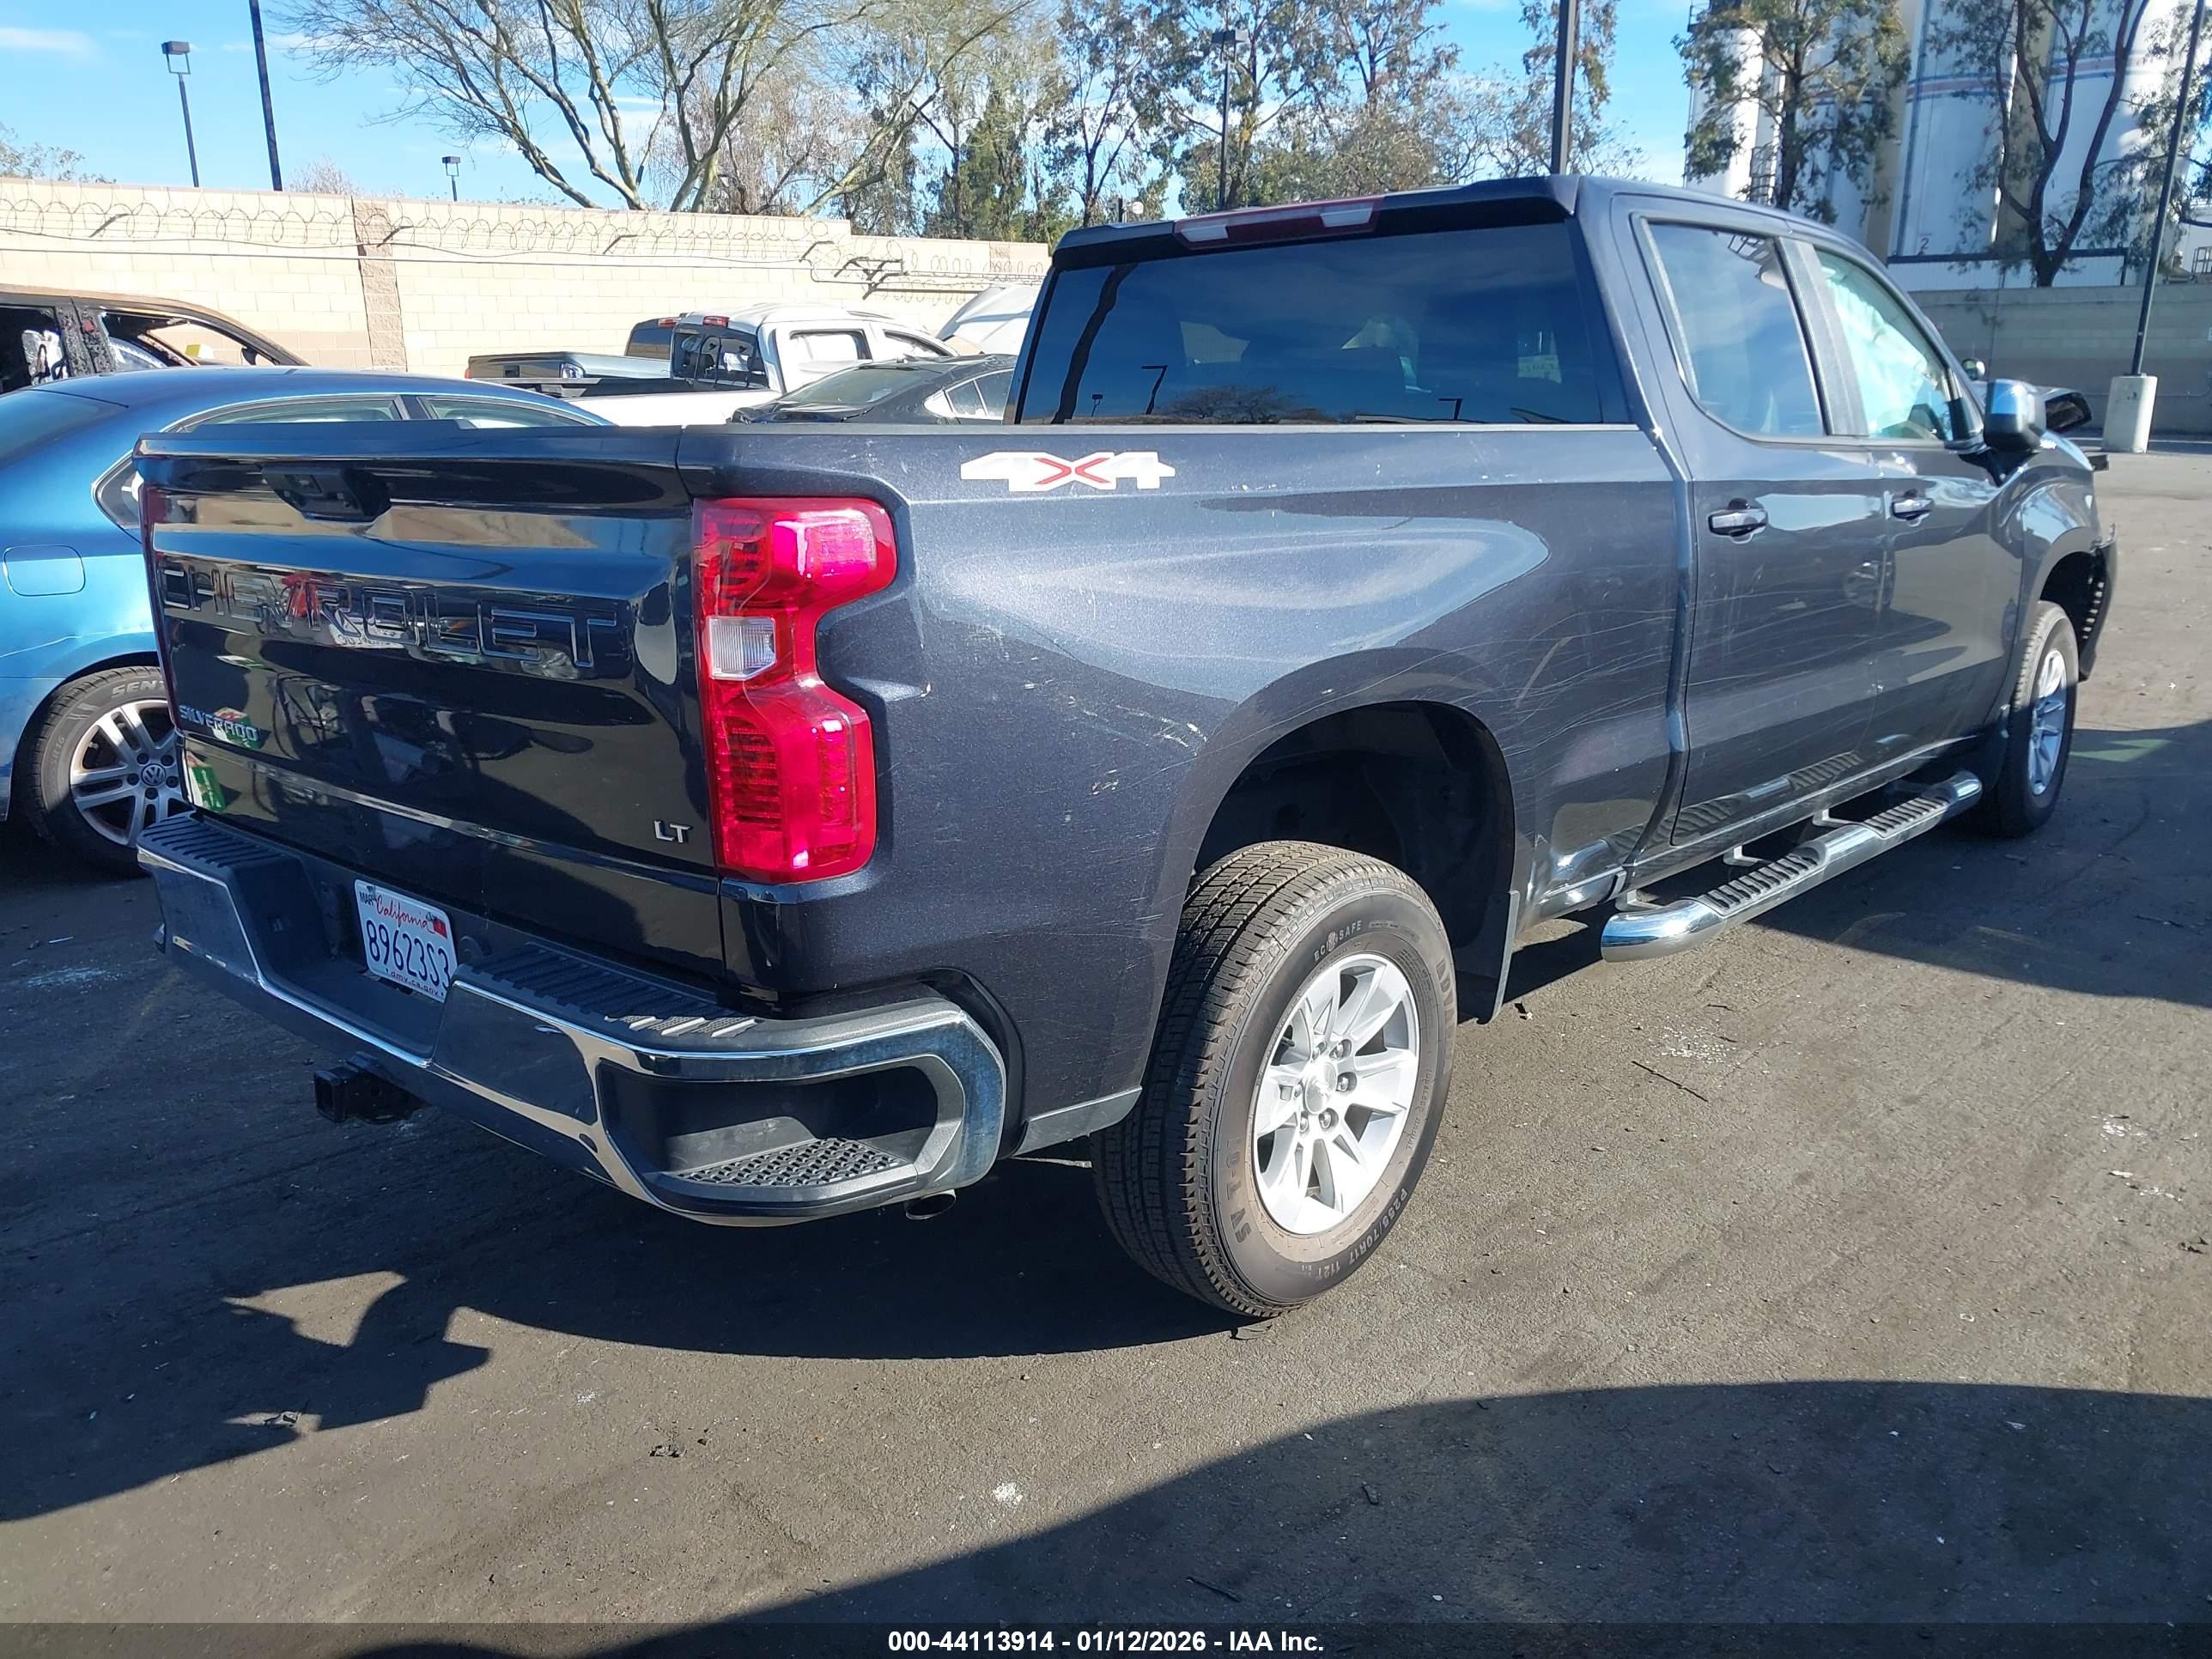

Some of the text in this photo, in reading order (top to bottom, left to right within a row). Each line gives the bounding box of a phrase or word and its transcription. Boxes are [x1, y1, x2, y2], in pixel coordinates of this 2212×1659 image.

[161, 564, 617, 668] CHEVROLET
[178, 704, 258, 742] SILVERADO
[653, 819, 691, 843] LT
[376, 894, 436, 933] California
[366, 919, 452, 988] 89623S3
